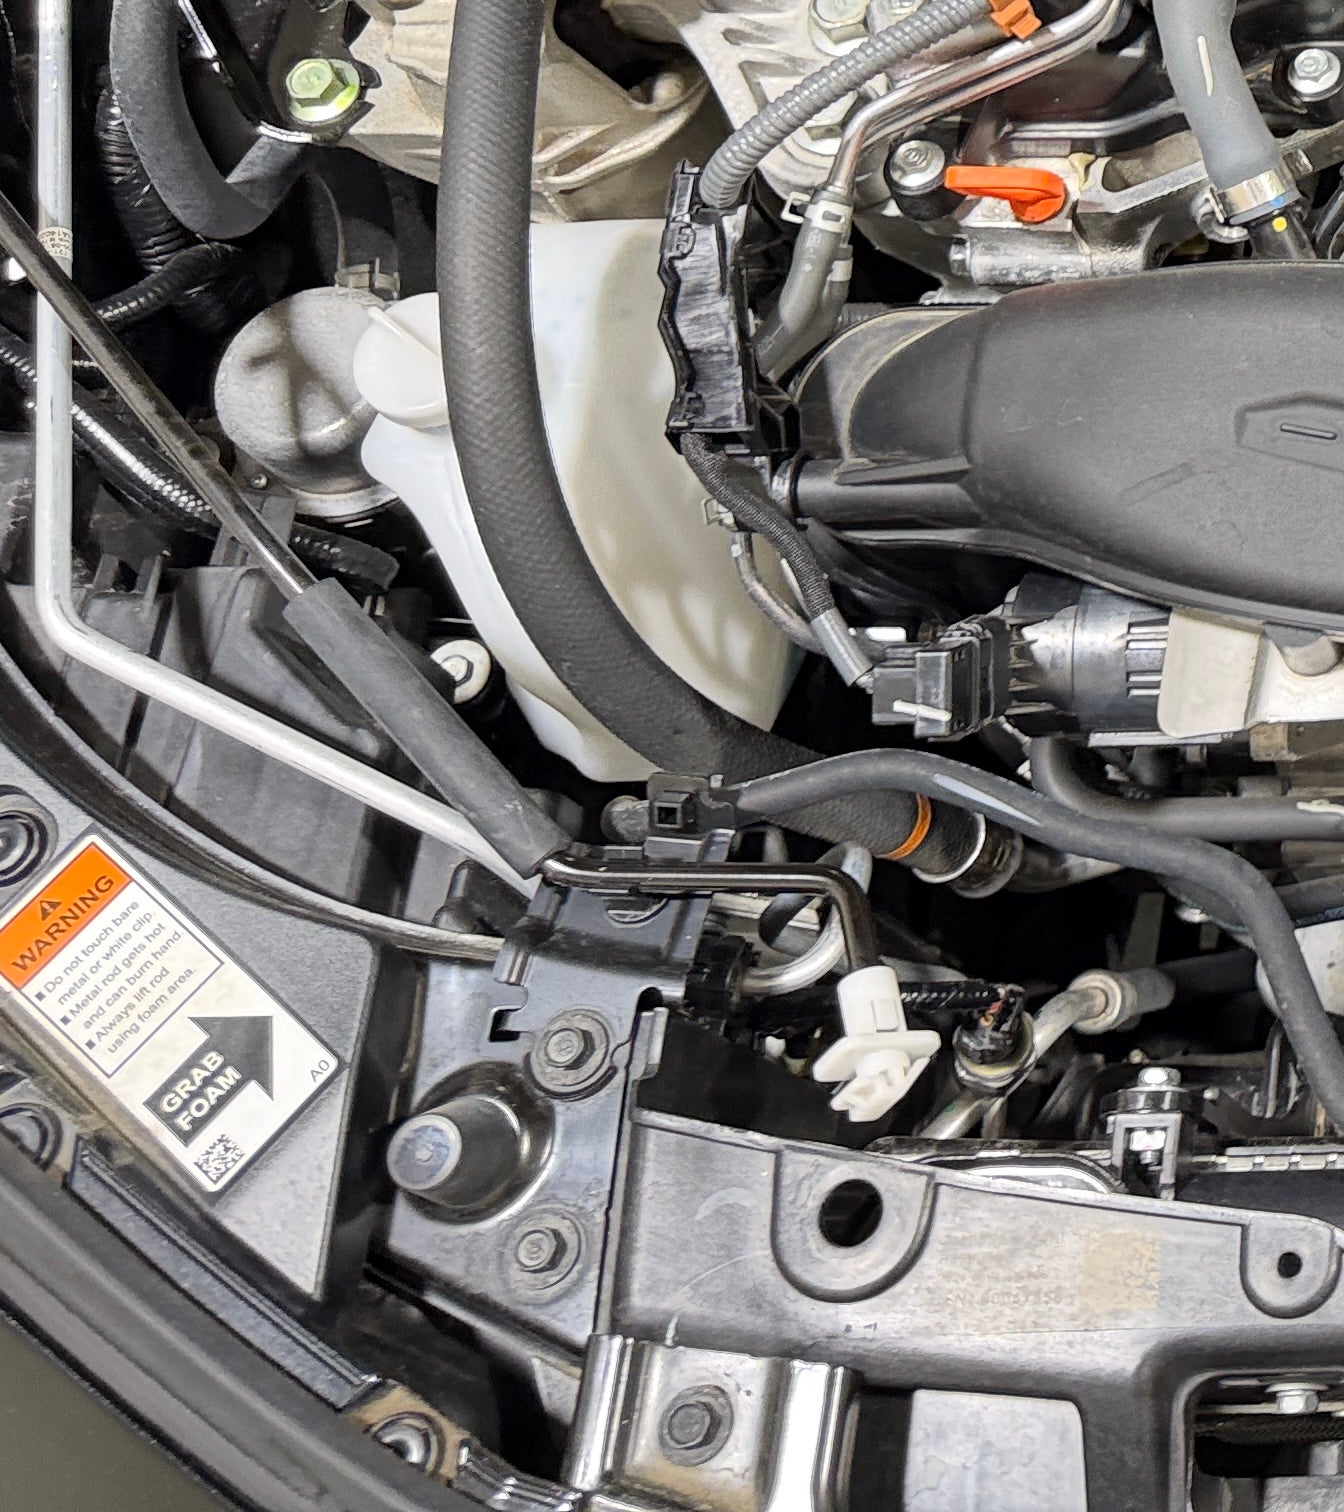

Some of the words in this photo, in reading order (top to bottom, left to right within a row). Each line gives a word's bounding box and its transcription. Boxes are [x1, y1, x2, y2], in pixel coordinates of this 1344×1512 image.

[13, 875, 115, 973] WARNING
[43, 974, 62, 994] Do
[59, 954, 84, 978] not
[80, 923, 114, 957] touch
[111, 898, 140, 927] bare
[56, 970, 90, 1005] metal
[88, 959, 102, 974] or
[99, 929, 133, 962] white
[69, 983, 102, 1017] Metal
[100, 964, 121, 987] rod
[118, 940, 148, 970] gets
[144, 921, 165, 943] hot
[80, 1003, 105, 1029] and
[103, 983, 127, 1007] can
[125, 957, 153, 985] burn
[150, 927, 184, 960] hand.
[93, 999, 137, 1043] Always
[132, 985, 149, 1002] lift
[147, 965, 170, 988] rod
[106, 1020, 141, 1056] using
[136, 991, 168, 1023] foam
[166, 964, 196, 995] area.
[157, 1048, 225, 1115] GRAB
[175, 1065, 242, 1132] FOAM
